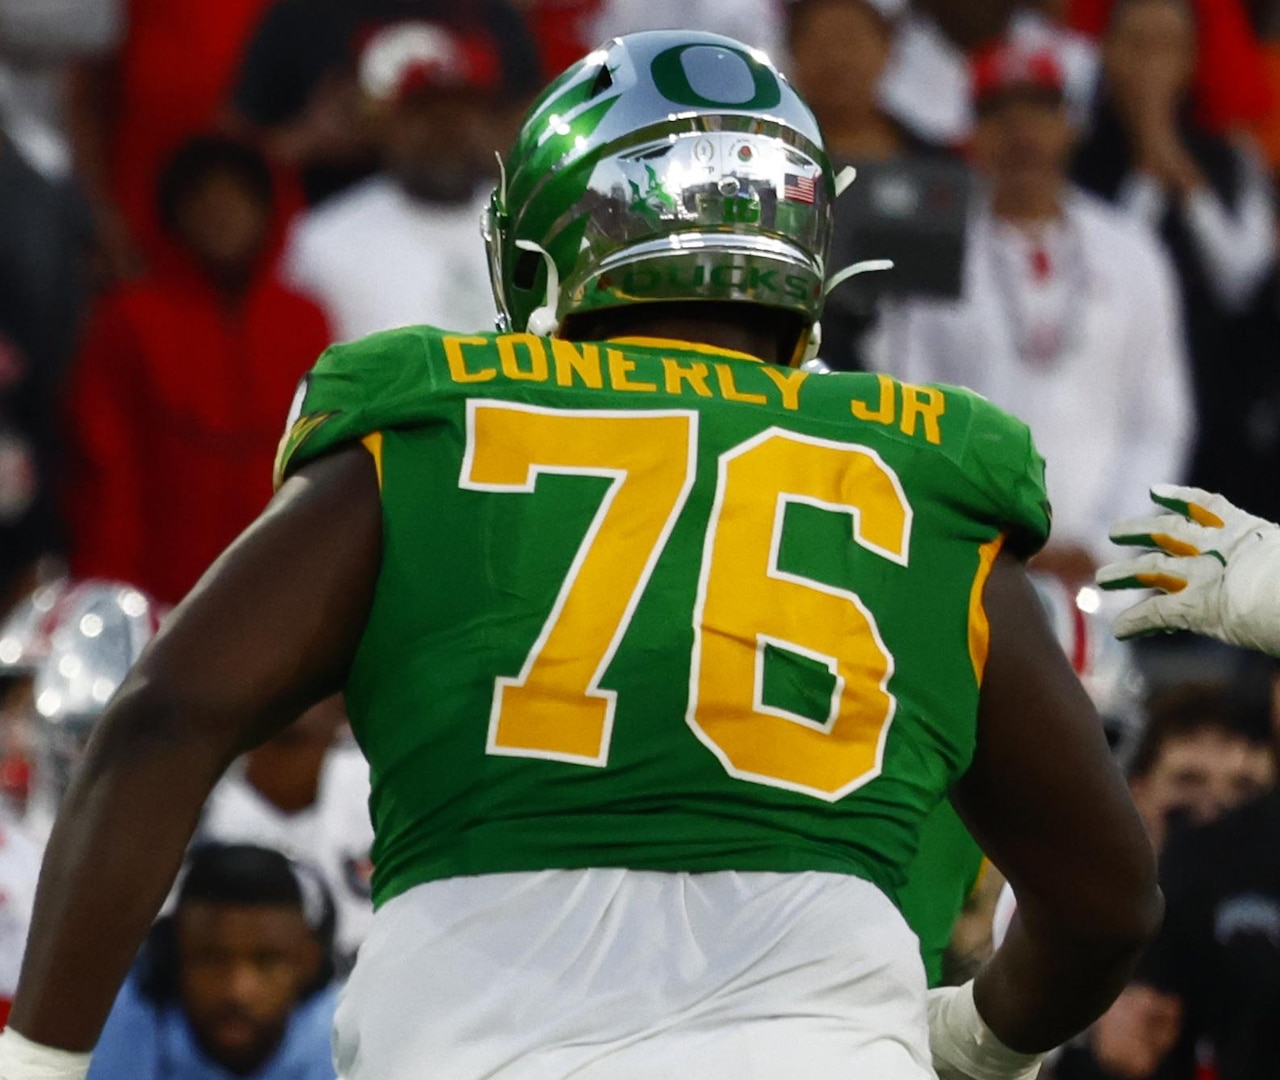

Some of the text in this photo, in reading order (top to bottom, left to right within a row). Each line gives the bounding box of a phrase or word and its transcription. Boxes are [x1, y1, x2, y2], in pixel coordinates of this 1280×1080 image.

[623, 264, 808, 299] DUCKS
[441, 334, 945, 445] CONERLY JR
[458, 397, 914, 803] 76
